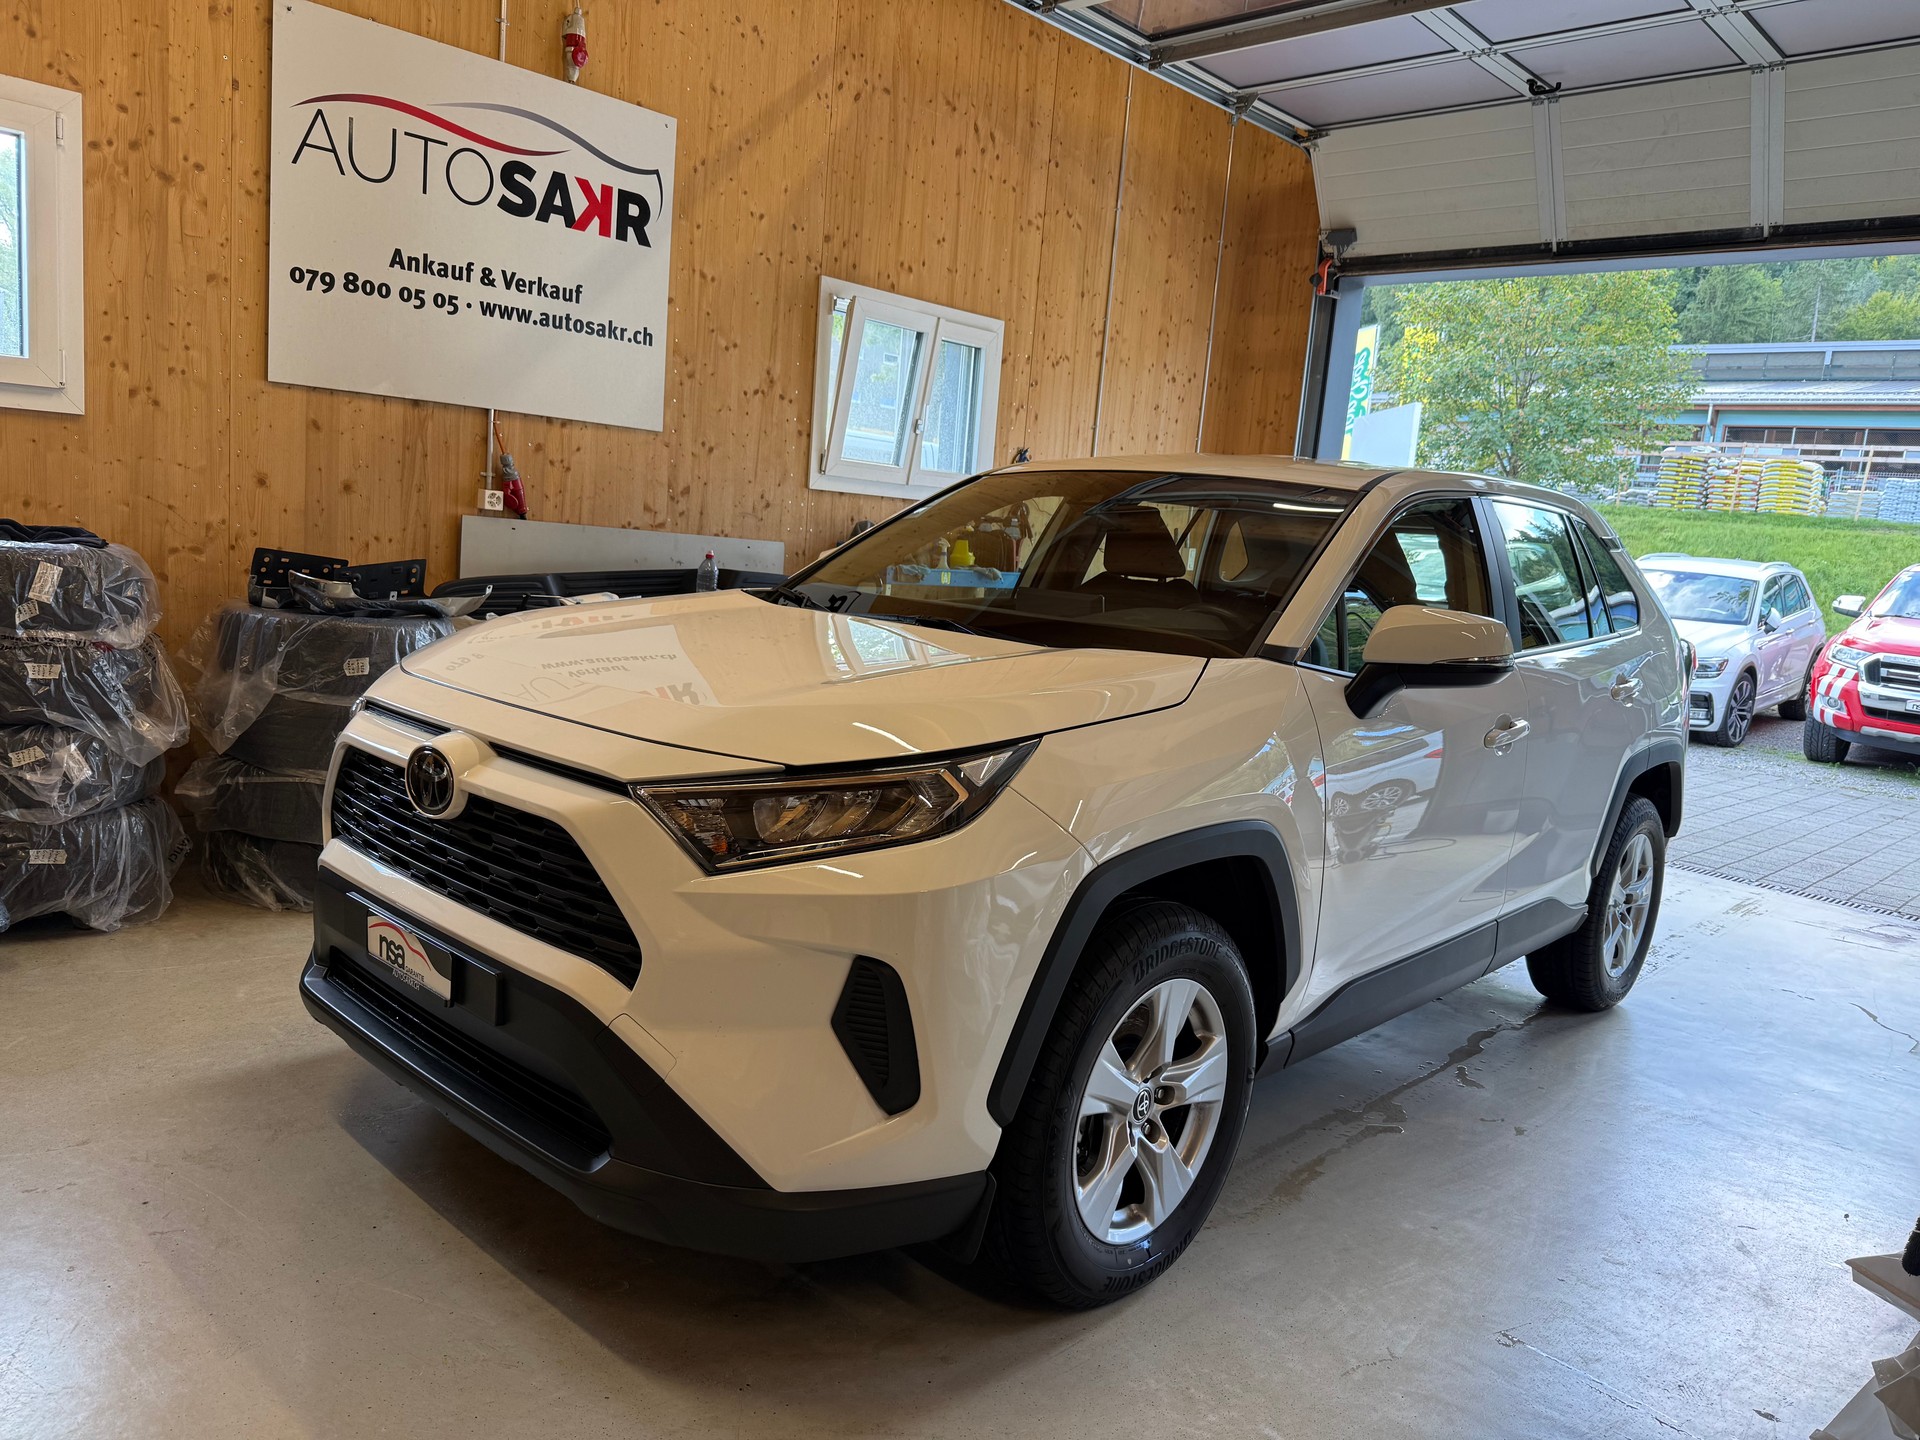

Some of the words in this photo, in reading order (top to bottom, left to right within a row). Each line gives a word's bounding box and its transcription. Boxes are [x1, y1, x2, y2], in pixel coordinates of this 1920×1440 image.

[388, 247, 475, 284] Ankauf
[479, 266, 497, 288] &
[500, 268, 584, 305] Verkauf
[289, 266, 336, 294] 079
[342, 271, 392, 300] 800
[398, 286, 426, 310] 05
[432, 292, 459, 316] 05
[479, 300, 653, 347] www.autosakr.ch
[379, 934, 406, 971] nsa
[1132, 936, 1223, 987] BRIDGESTONE
